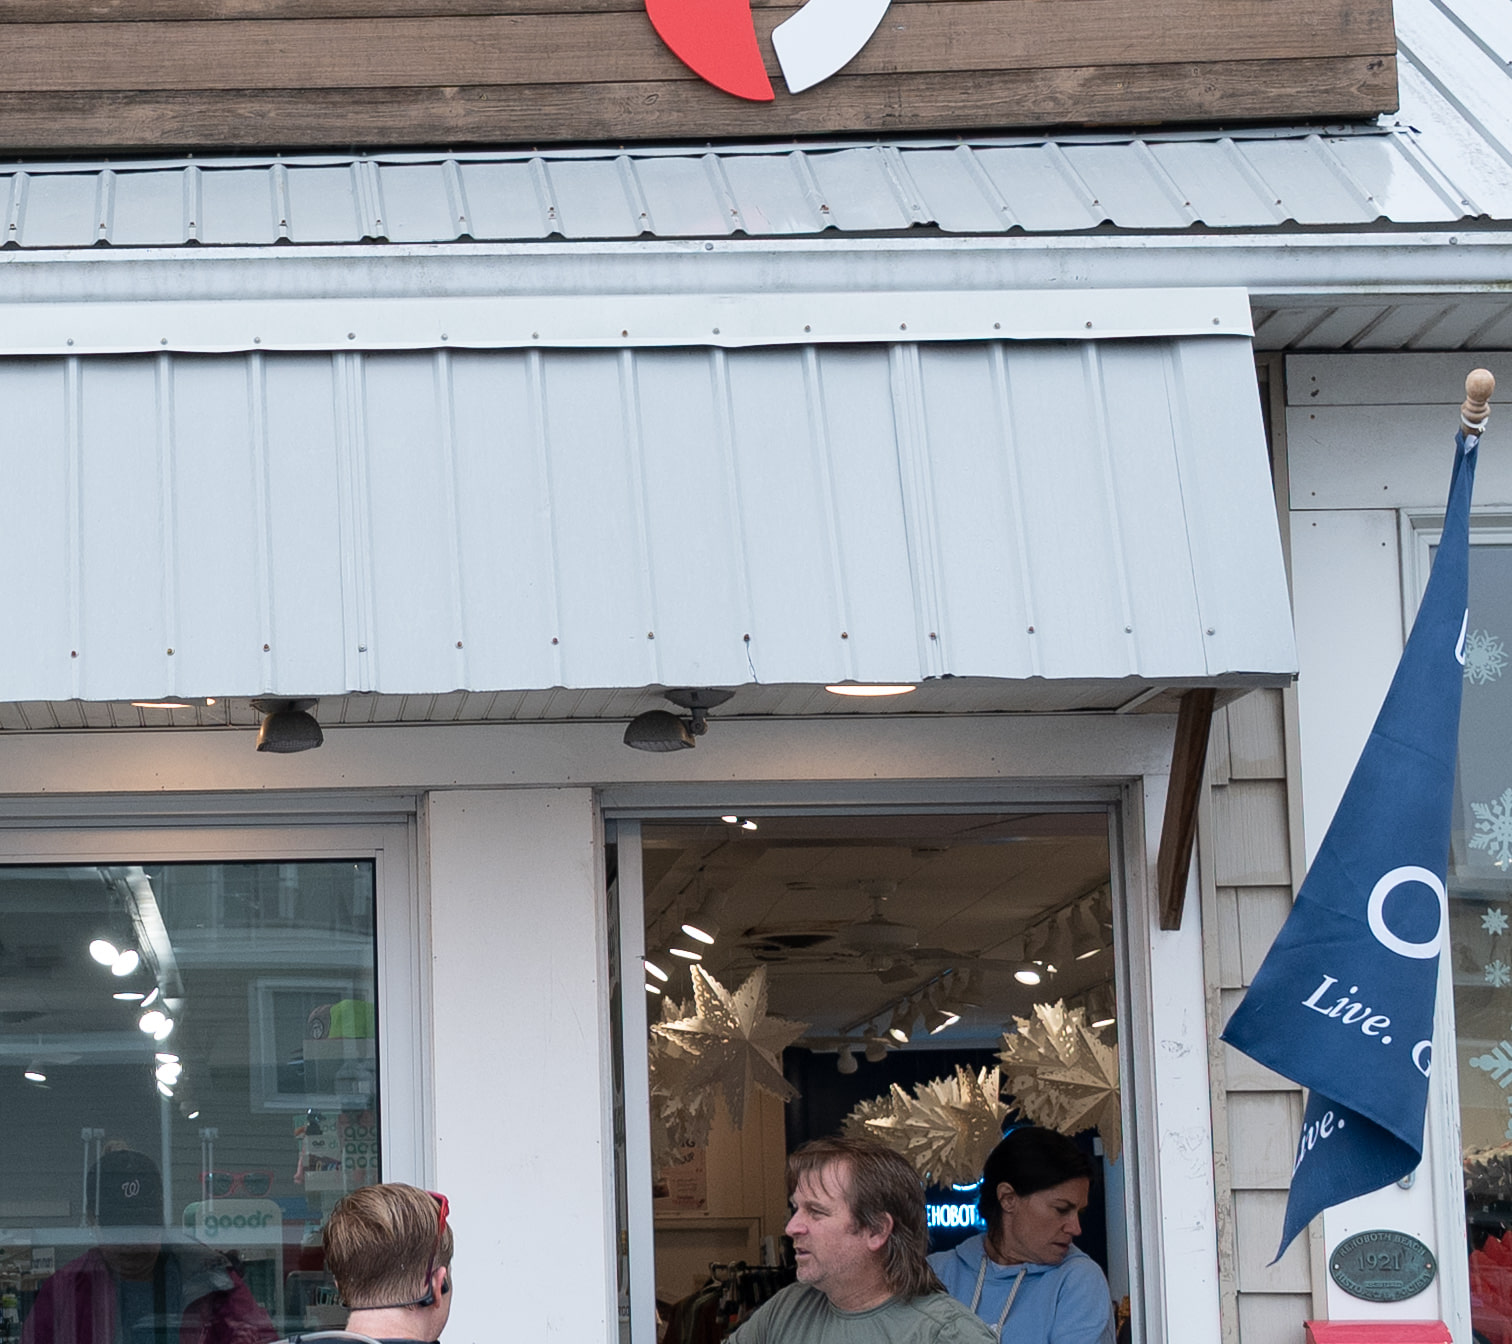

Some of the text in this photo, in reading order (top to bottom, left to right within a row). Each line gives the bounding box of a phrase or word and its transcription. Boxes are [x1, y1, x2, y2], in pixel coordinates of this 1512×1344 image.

[1301, 974, 1392, 1045] Live.
[204, 1210, 274, 1237] goodr
[1358, 1252, 1401, 1272] 1921
